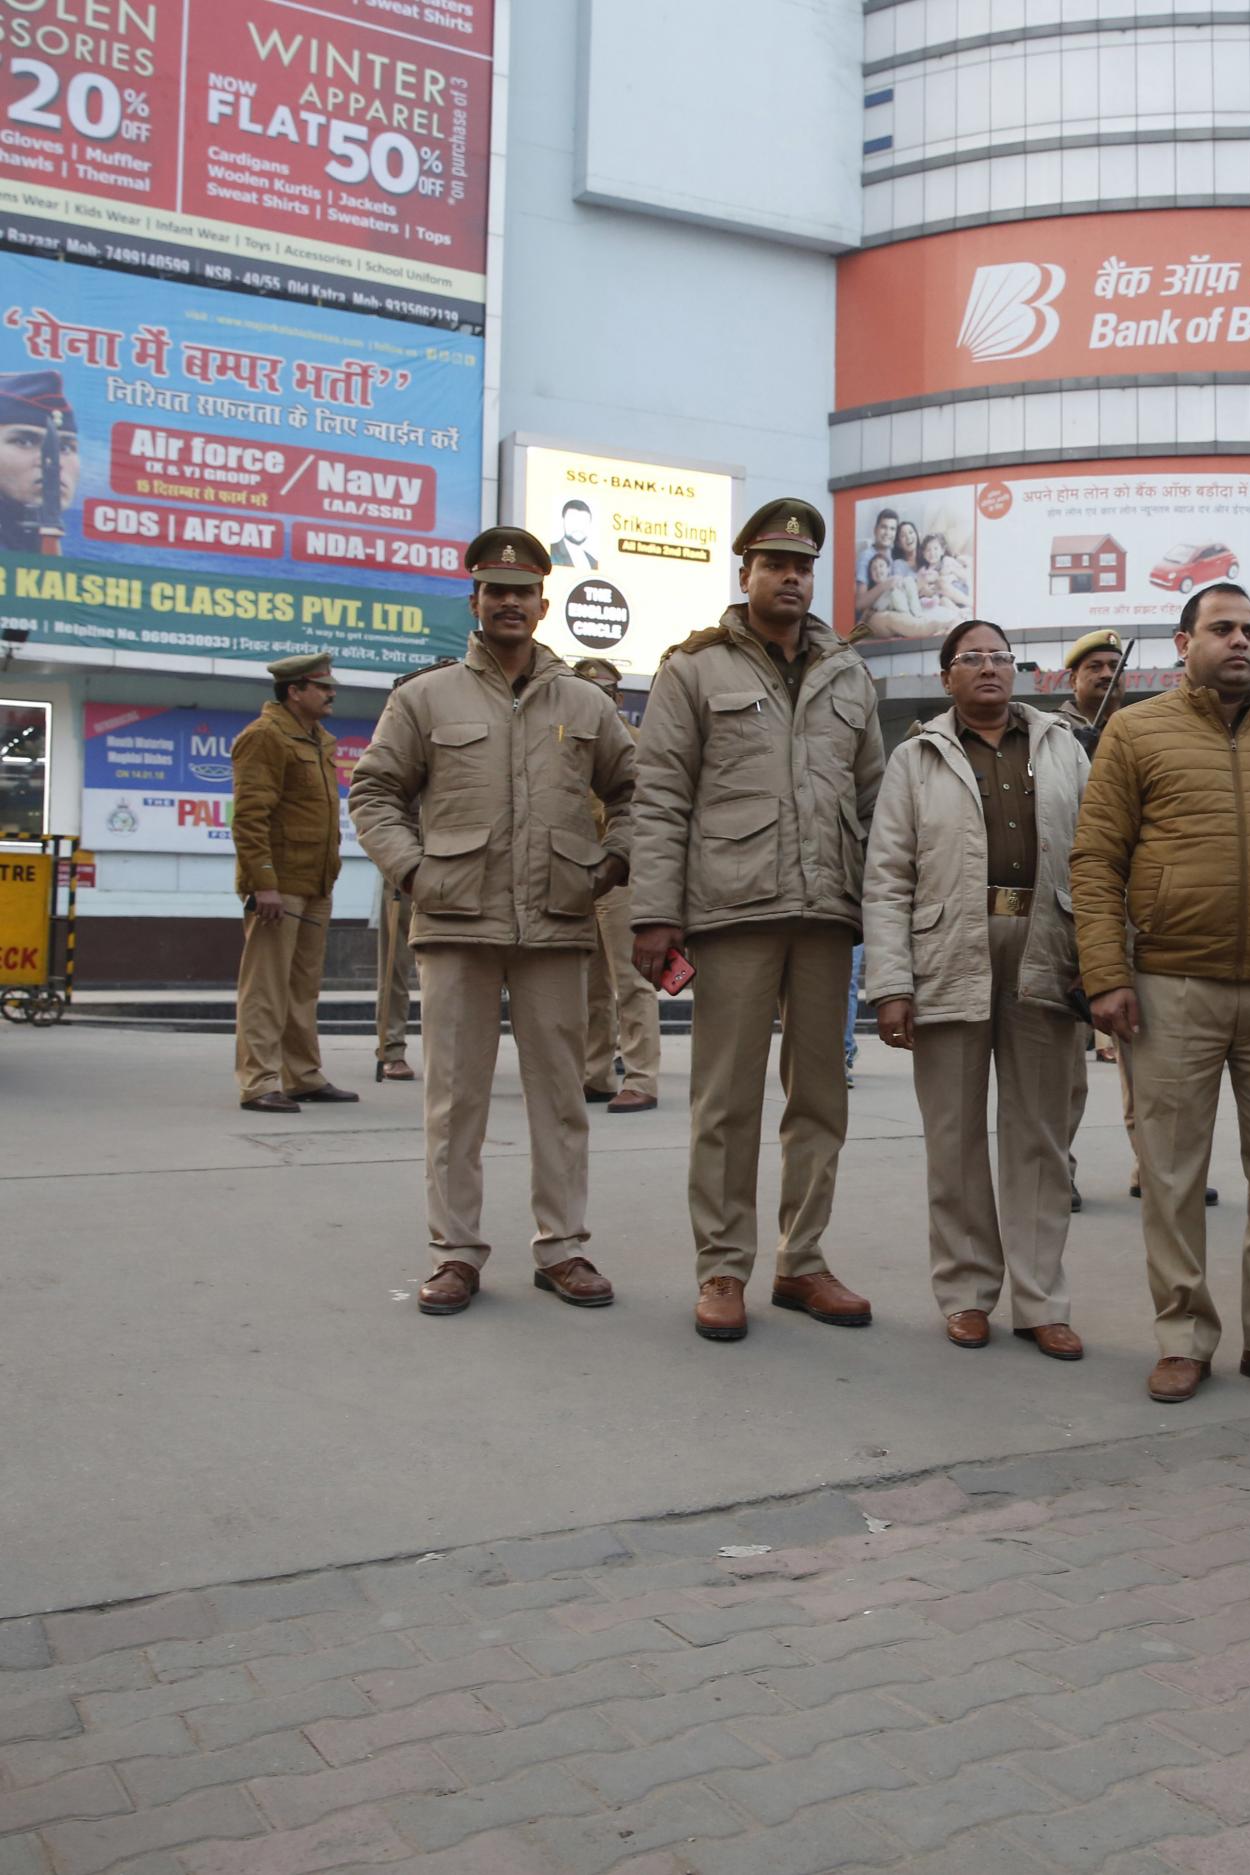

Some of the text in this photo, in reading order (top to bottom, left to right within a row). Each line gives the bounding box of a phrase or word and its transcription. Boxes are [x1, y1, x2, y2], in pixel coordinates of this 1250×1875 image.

[2, 0, 156, 43] LEN
[423, 8, 473, 34] Shirts
[0, 14, 154, 77] SORIES
[247, 21, 446, 107] WINTER
[8, 57, 122, 140] 20
[121, 120, 152, 142] OFF
[208, 72, 257, 98] NOW
[299, 82, 445, 140] APPAREL
[449, 76, 469, 178] purchase of 3
[1, 129, 152, 173] Gloves Muffler
[207, 145, 290, 176] Cardigans
[75, 163, 150, 192] Thermal
[207, 163, 398, 217] Woolen Kurtis Jackets
[418, 176, 444, 198] OFF
[207, 182, 453, 246] Sweat Shirts Sweaters Tops
[22, 193, 453, 288] Wear Kids Wear Infant Wear Toys Accessories School Uniform
[1093, 255, 1154, 300] बैंक
[1088, 308, 1182, 349] Bank
[1185, 306, 1225, 344] of
[134, 326, 171, 377] में
[183, 343, 283, 394] बम्पर
[197, 394, 281, 428] सफलता
[288, 404, 308, 431] के
[315, 407, 359, 437] लिए
[431, 427, 461, 451] करें
[130, 428, 423, 506] Air force Navy
[203, 467, 261, 486] GROUP
[566, 470, 695, 498] SSC BANK IAS
[1022, 488, 1052, 503] अपने
[1056, 484, 1080, 503] होम
[1083, 485, 1109, 500] लोन
[1113, 484, 1131, 499] को
[1237, 482, 1249, 497] में
[94, 505, 276, 550] CDS AFCAT
[612, 512, 717, 545] Srikant Singh
[306, 530, 460, 571] NDA-I 2018
[15, 567, 142, 610] KALSHI
[151, 581, 294, 623] CLASSES
[302, 594, 366, 629] PVT.
[371, 601, 431, 635] LTD.
[54, 620, 115, 639] Helpline
[117, 626, 140, 641] No.
[335, 630, 345, 639] to
[0, 946, 38, 970] CK
